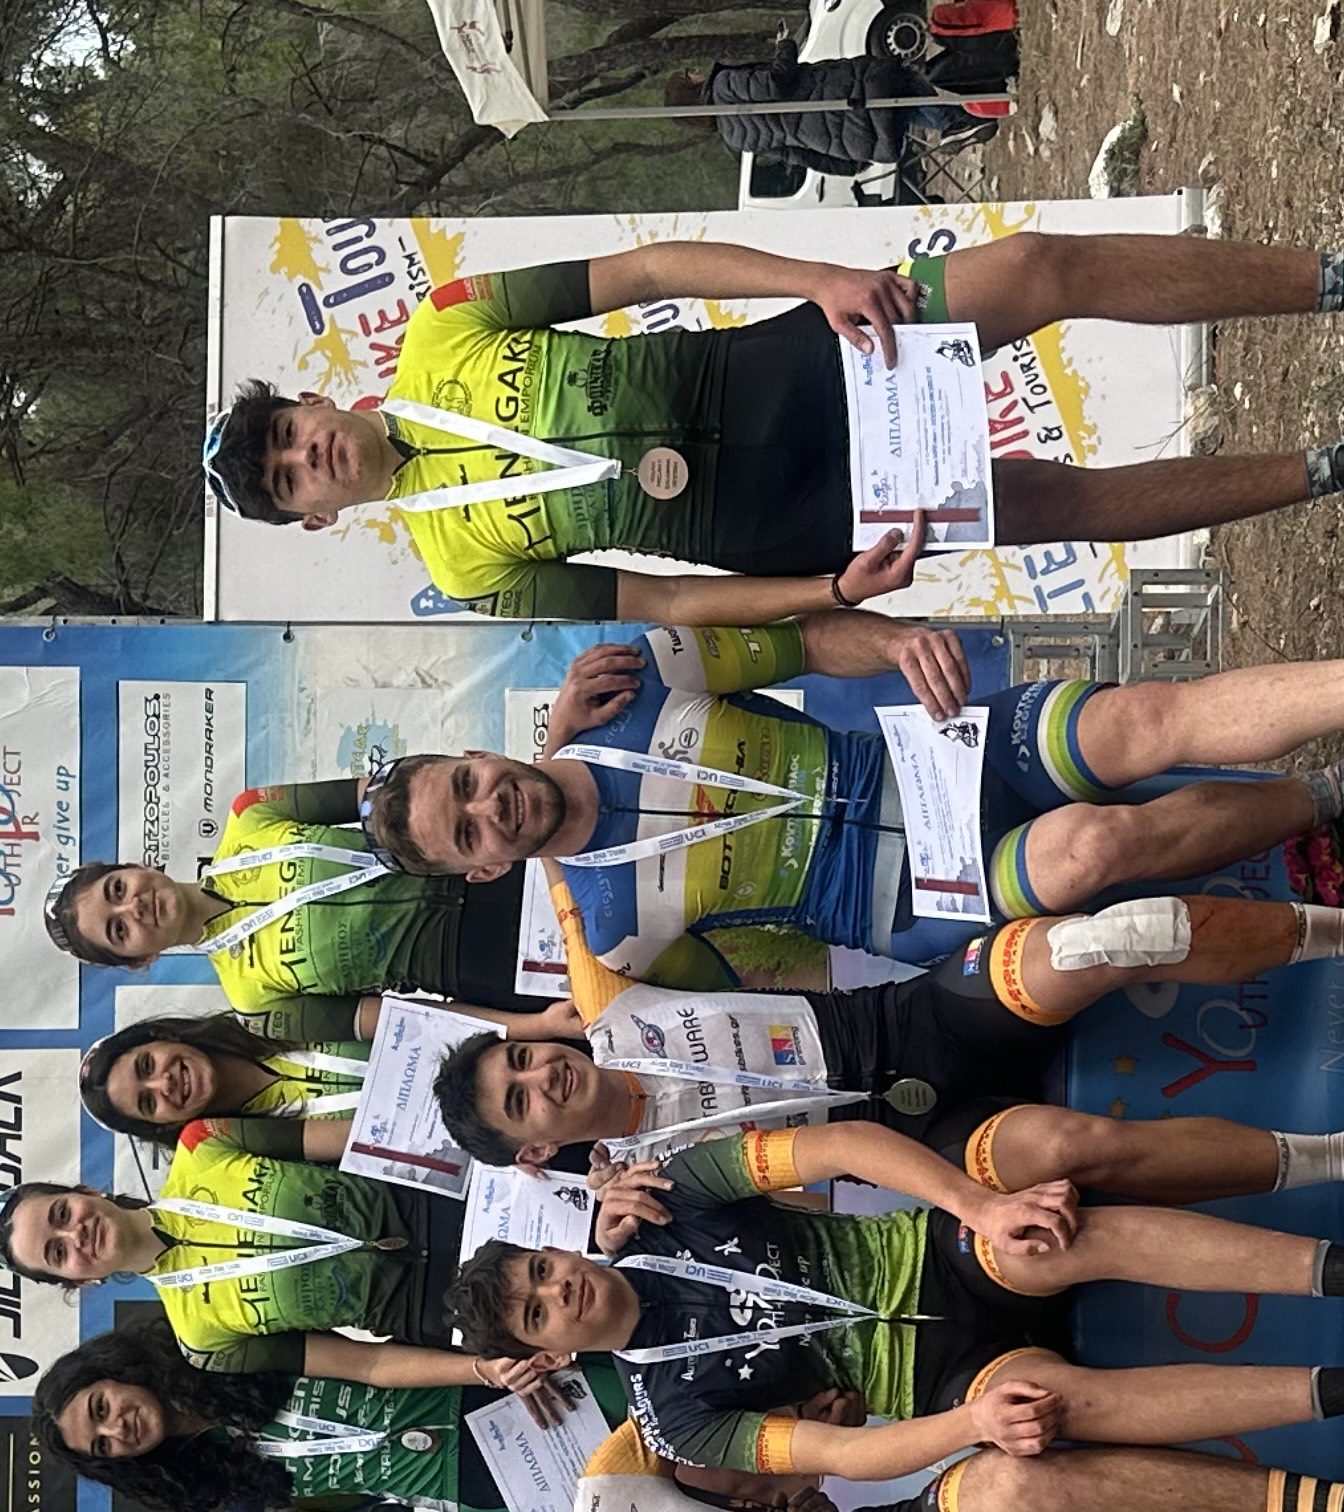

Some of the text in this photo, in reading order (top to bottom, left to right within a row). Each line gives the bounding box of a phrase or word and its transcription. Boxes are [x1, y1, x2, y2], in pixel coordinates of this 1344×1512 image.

[885, 373, 902, 458] ΔΙΠΛΩΜΑ
[204, 687, 215, 813] MONDRAKER
[57, 764, 77, 791] up
[697, 770, 718, 782] UCI
[53, 801, 77, 846] give
[687, 829, 707, 842] UCI
[515, 1431, 551, 1492] ΔΙΠΛΩΜΑ
